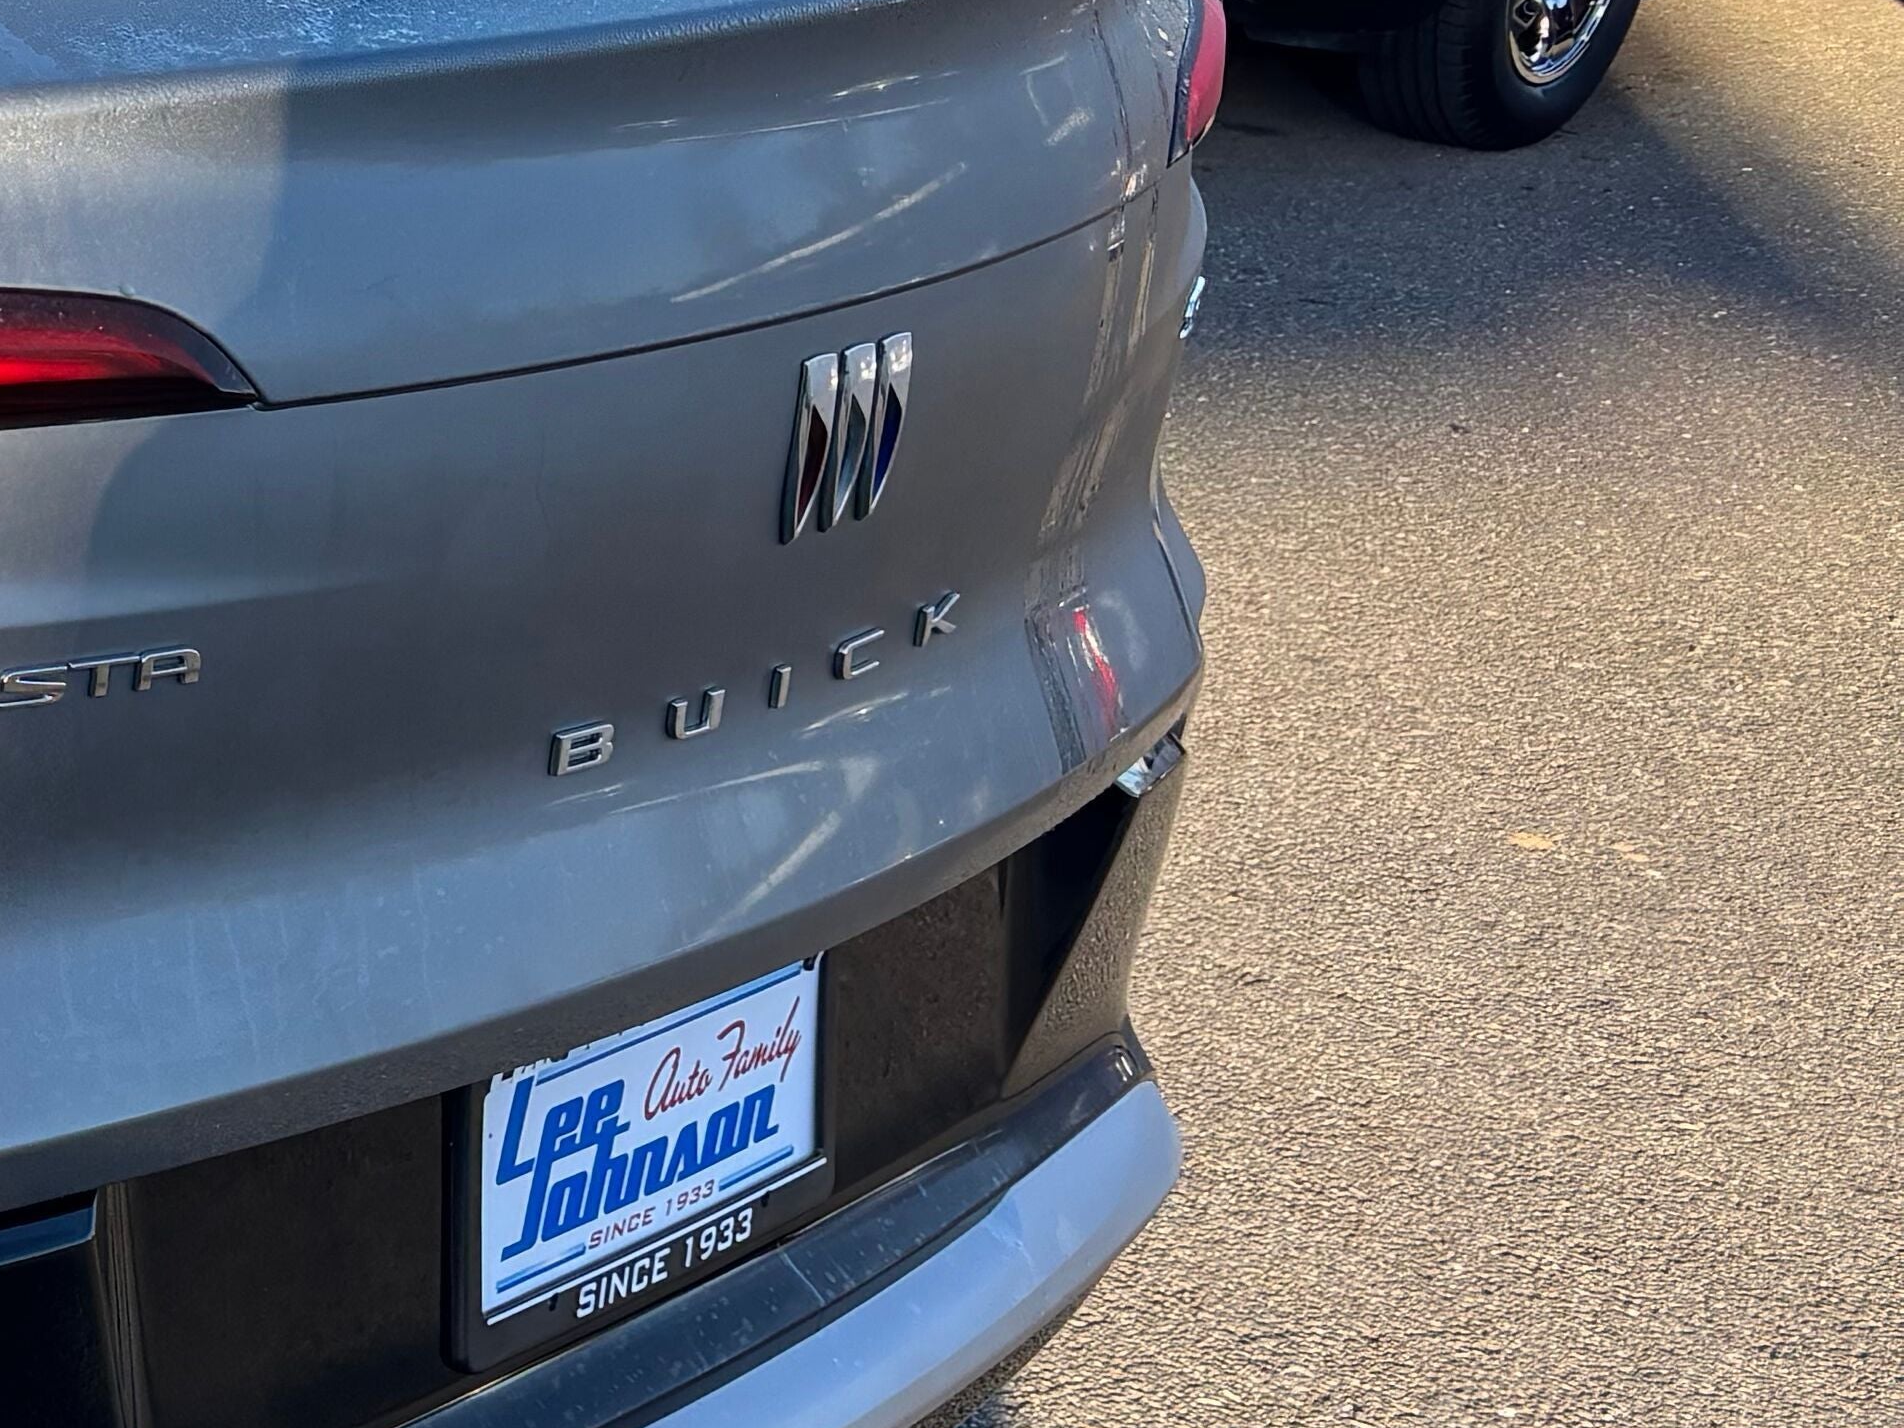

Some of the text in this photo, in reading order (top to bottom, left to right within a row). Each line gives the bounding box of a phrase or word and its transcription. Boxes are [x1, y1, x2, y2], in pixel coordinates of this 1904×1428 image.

[547, 590, 960, 777] BUICK
[643, 995, 801, 1122] Auto Family
[495, 1076, 626, 1186] Lee
[500, 1084, 780, 1262] Johnson
[575, 1207, 754, 1319] SINCE 1933
[587, 1178, 716, 1251] SINCE 1933
